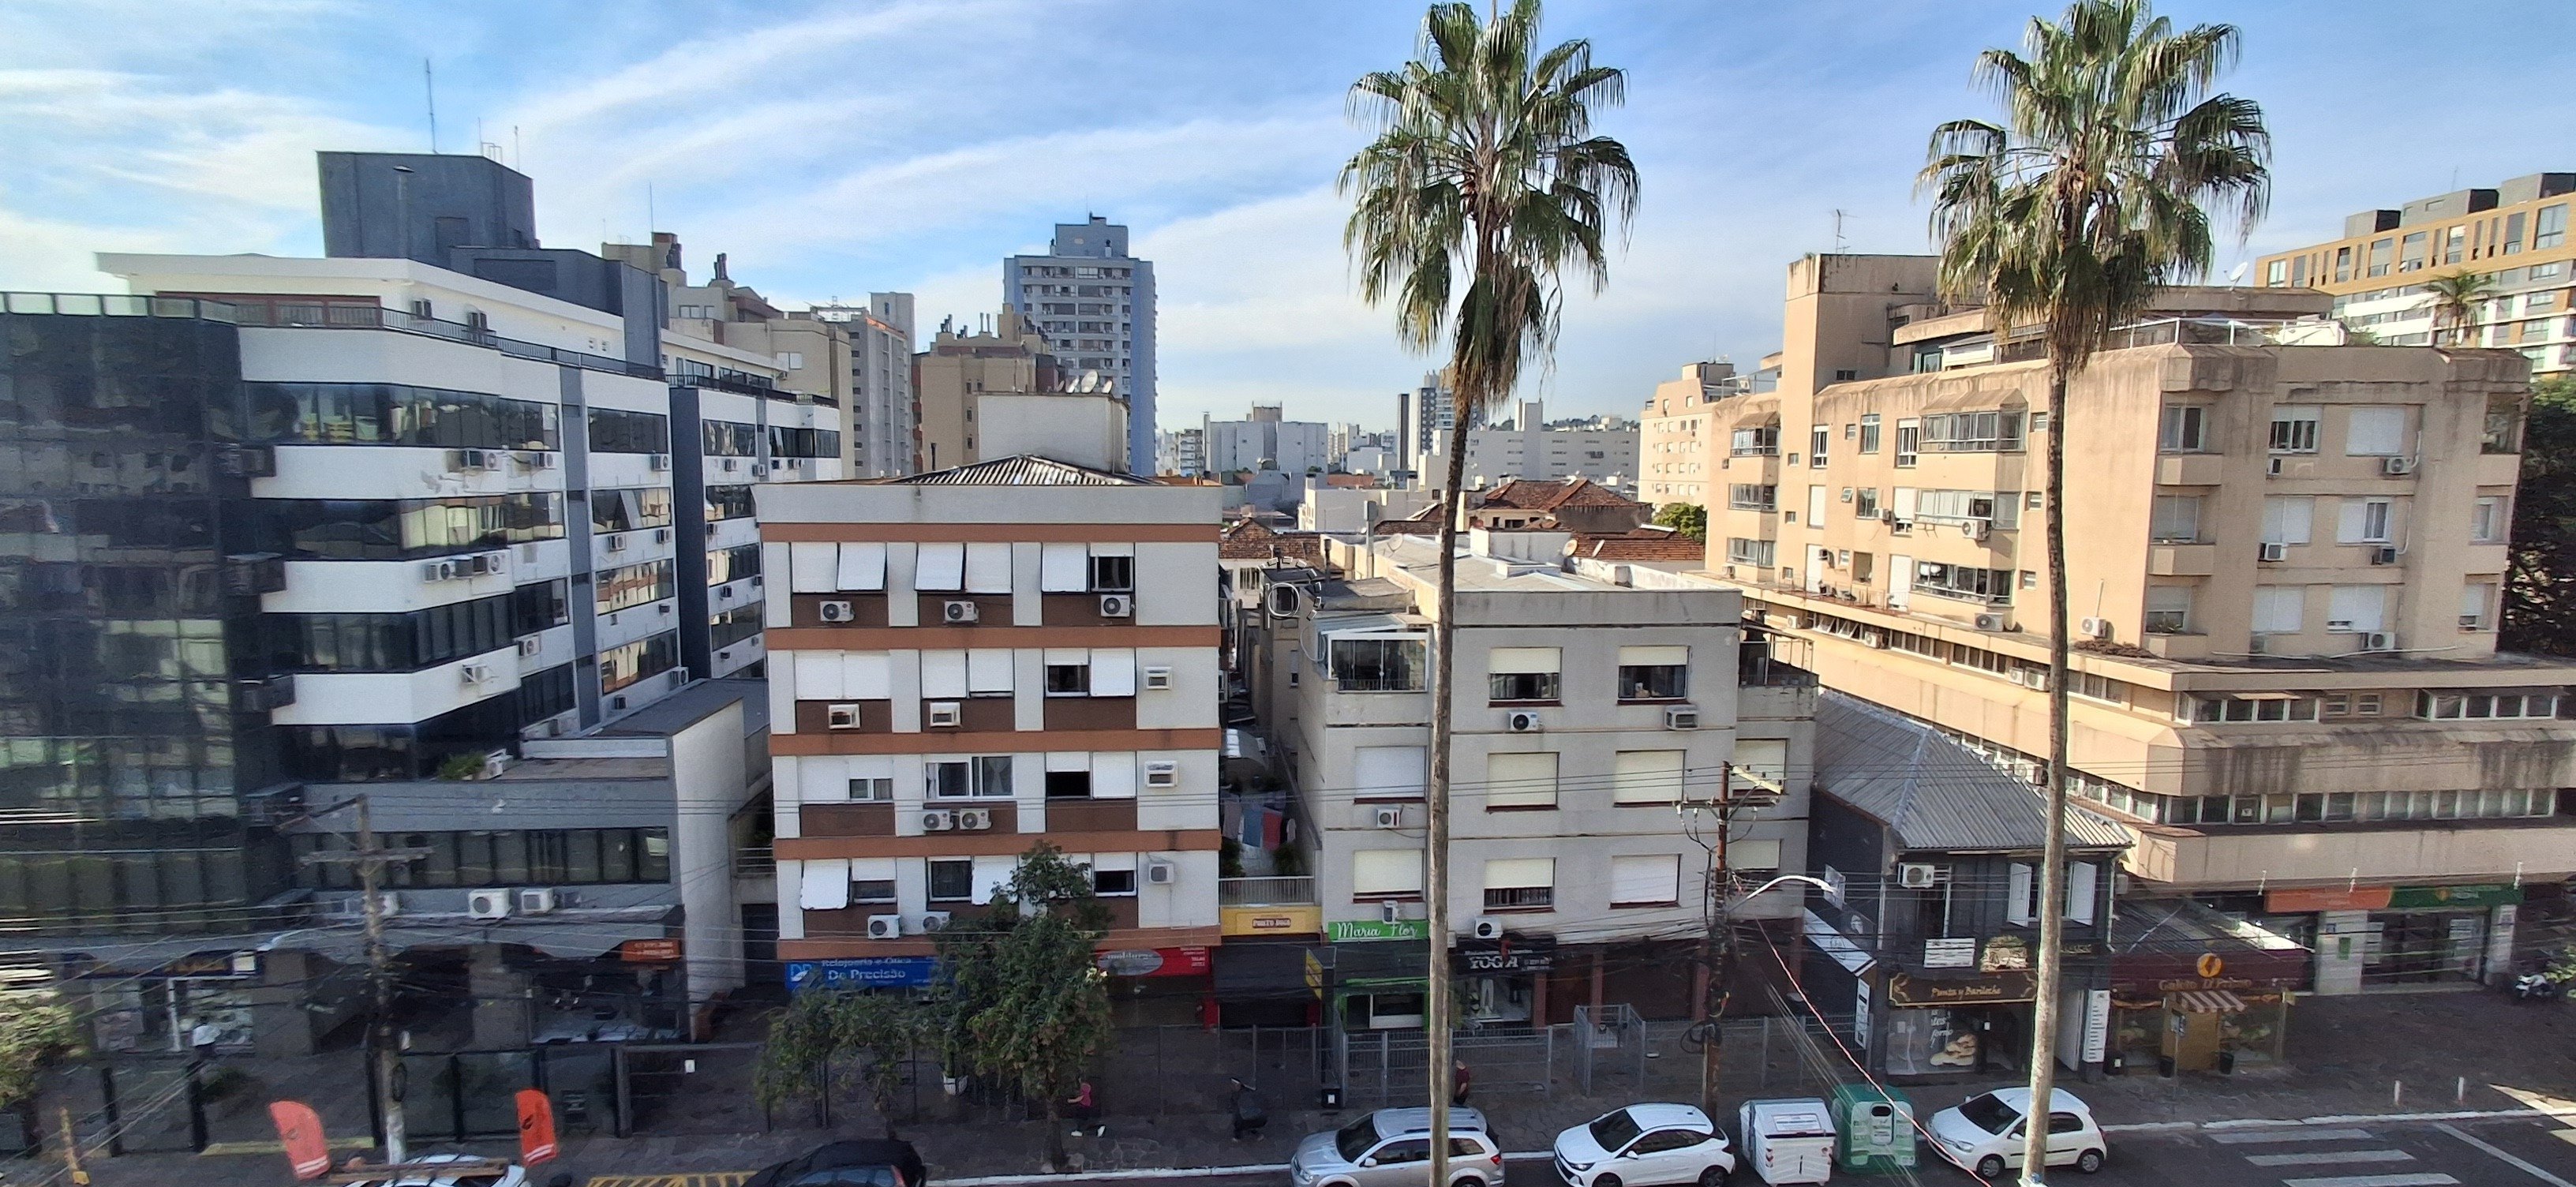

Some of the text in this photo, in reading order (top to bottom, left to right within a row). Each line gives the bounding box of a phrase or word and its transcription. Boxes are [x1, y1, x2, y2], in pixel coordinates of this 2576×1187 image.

[1337, 922, 1418, 938] Maria Flor
[1468, 955, 1519, 969] YOGA
[850, 968, 906, 979] Precisão
